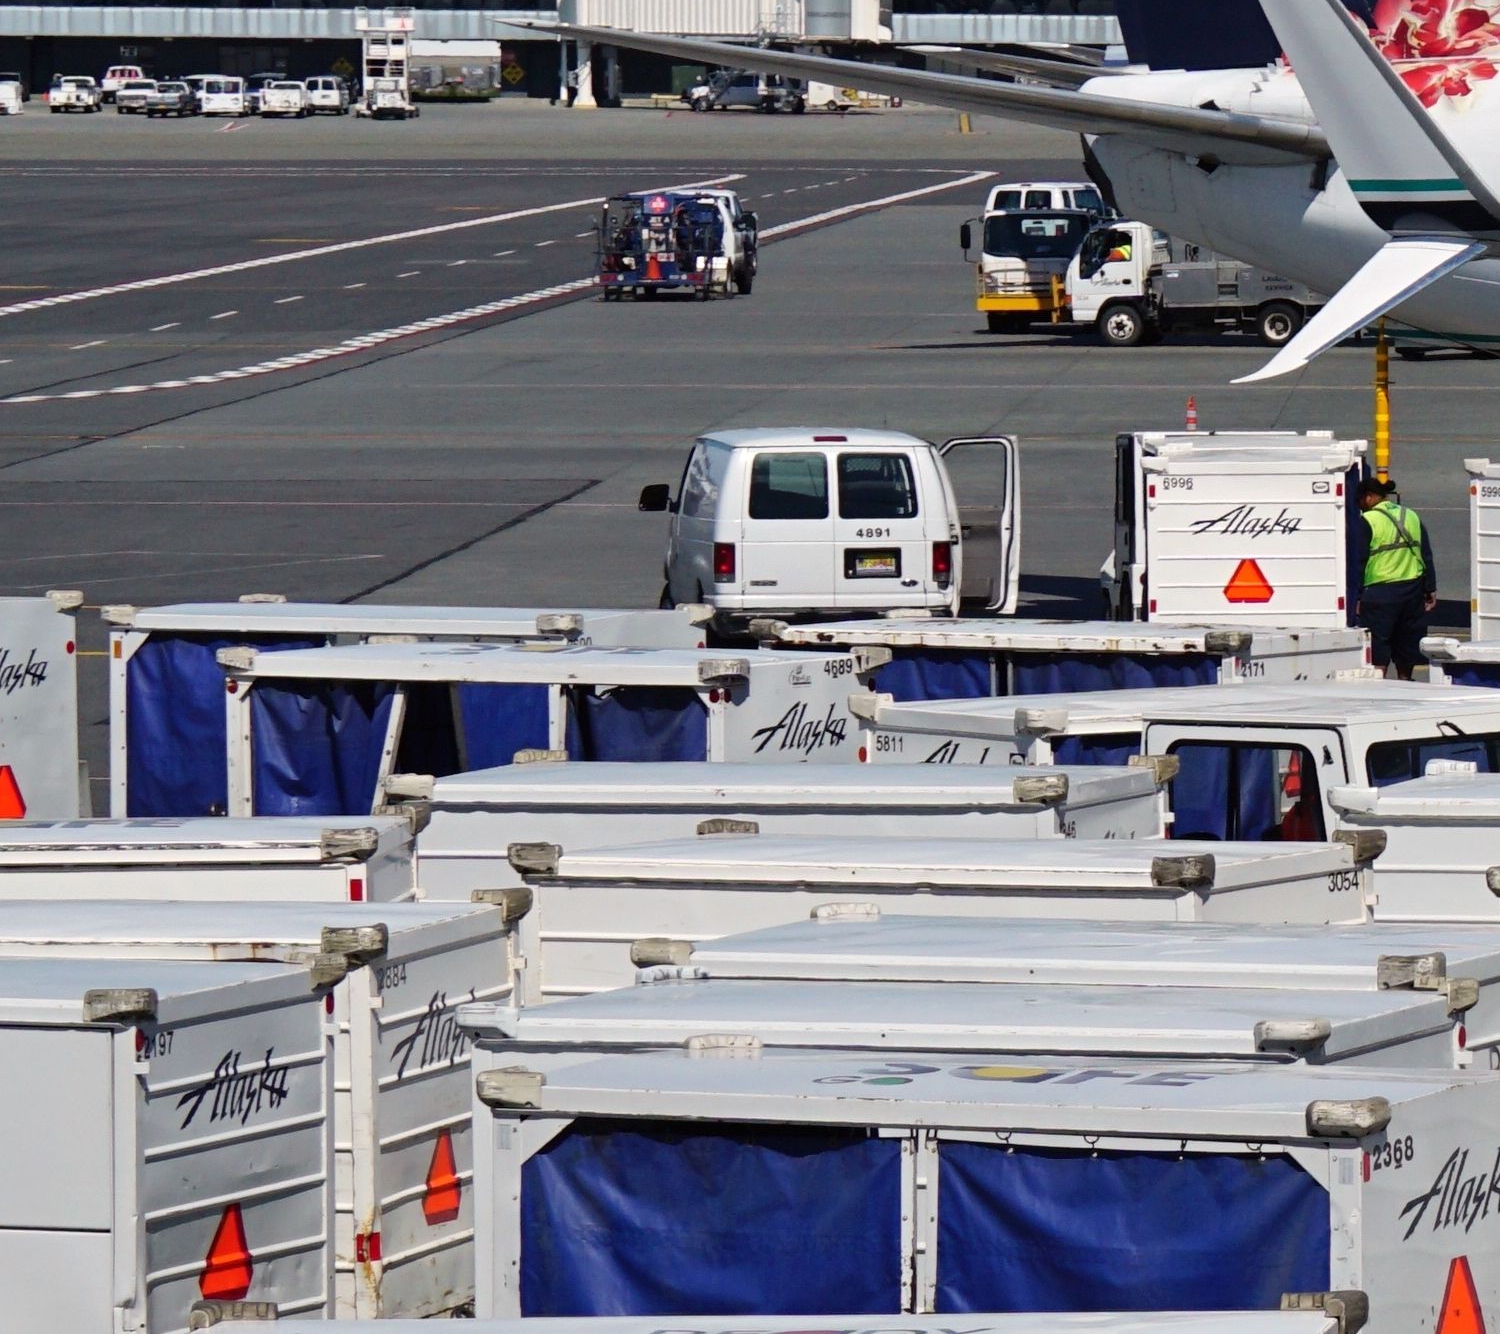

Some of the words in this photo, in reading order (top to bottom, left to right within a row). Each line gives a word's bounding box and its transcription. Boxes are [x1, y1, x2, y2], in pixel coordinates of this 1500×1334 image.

[1162, 477, 1194, 491] 6996
[1190, 504, 1303, 538] Alaska
[856, 528, 891, 539] 4891
[823, 658, 853, 678] 4689
[1241, 662, 1266, 679] 2171
[752, 701, 848, 755] Alaska
[876, 734, 905, 753] 5811
[1327, 871, 1360, 893] 3054
[144, 1031, 174, 1062] 2197
[177, 1047, 290, 1130] Alaska
[1372, 1137, 1415, 1171] 2368
